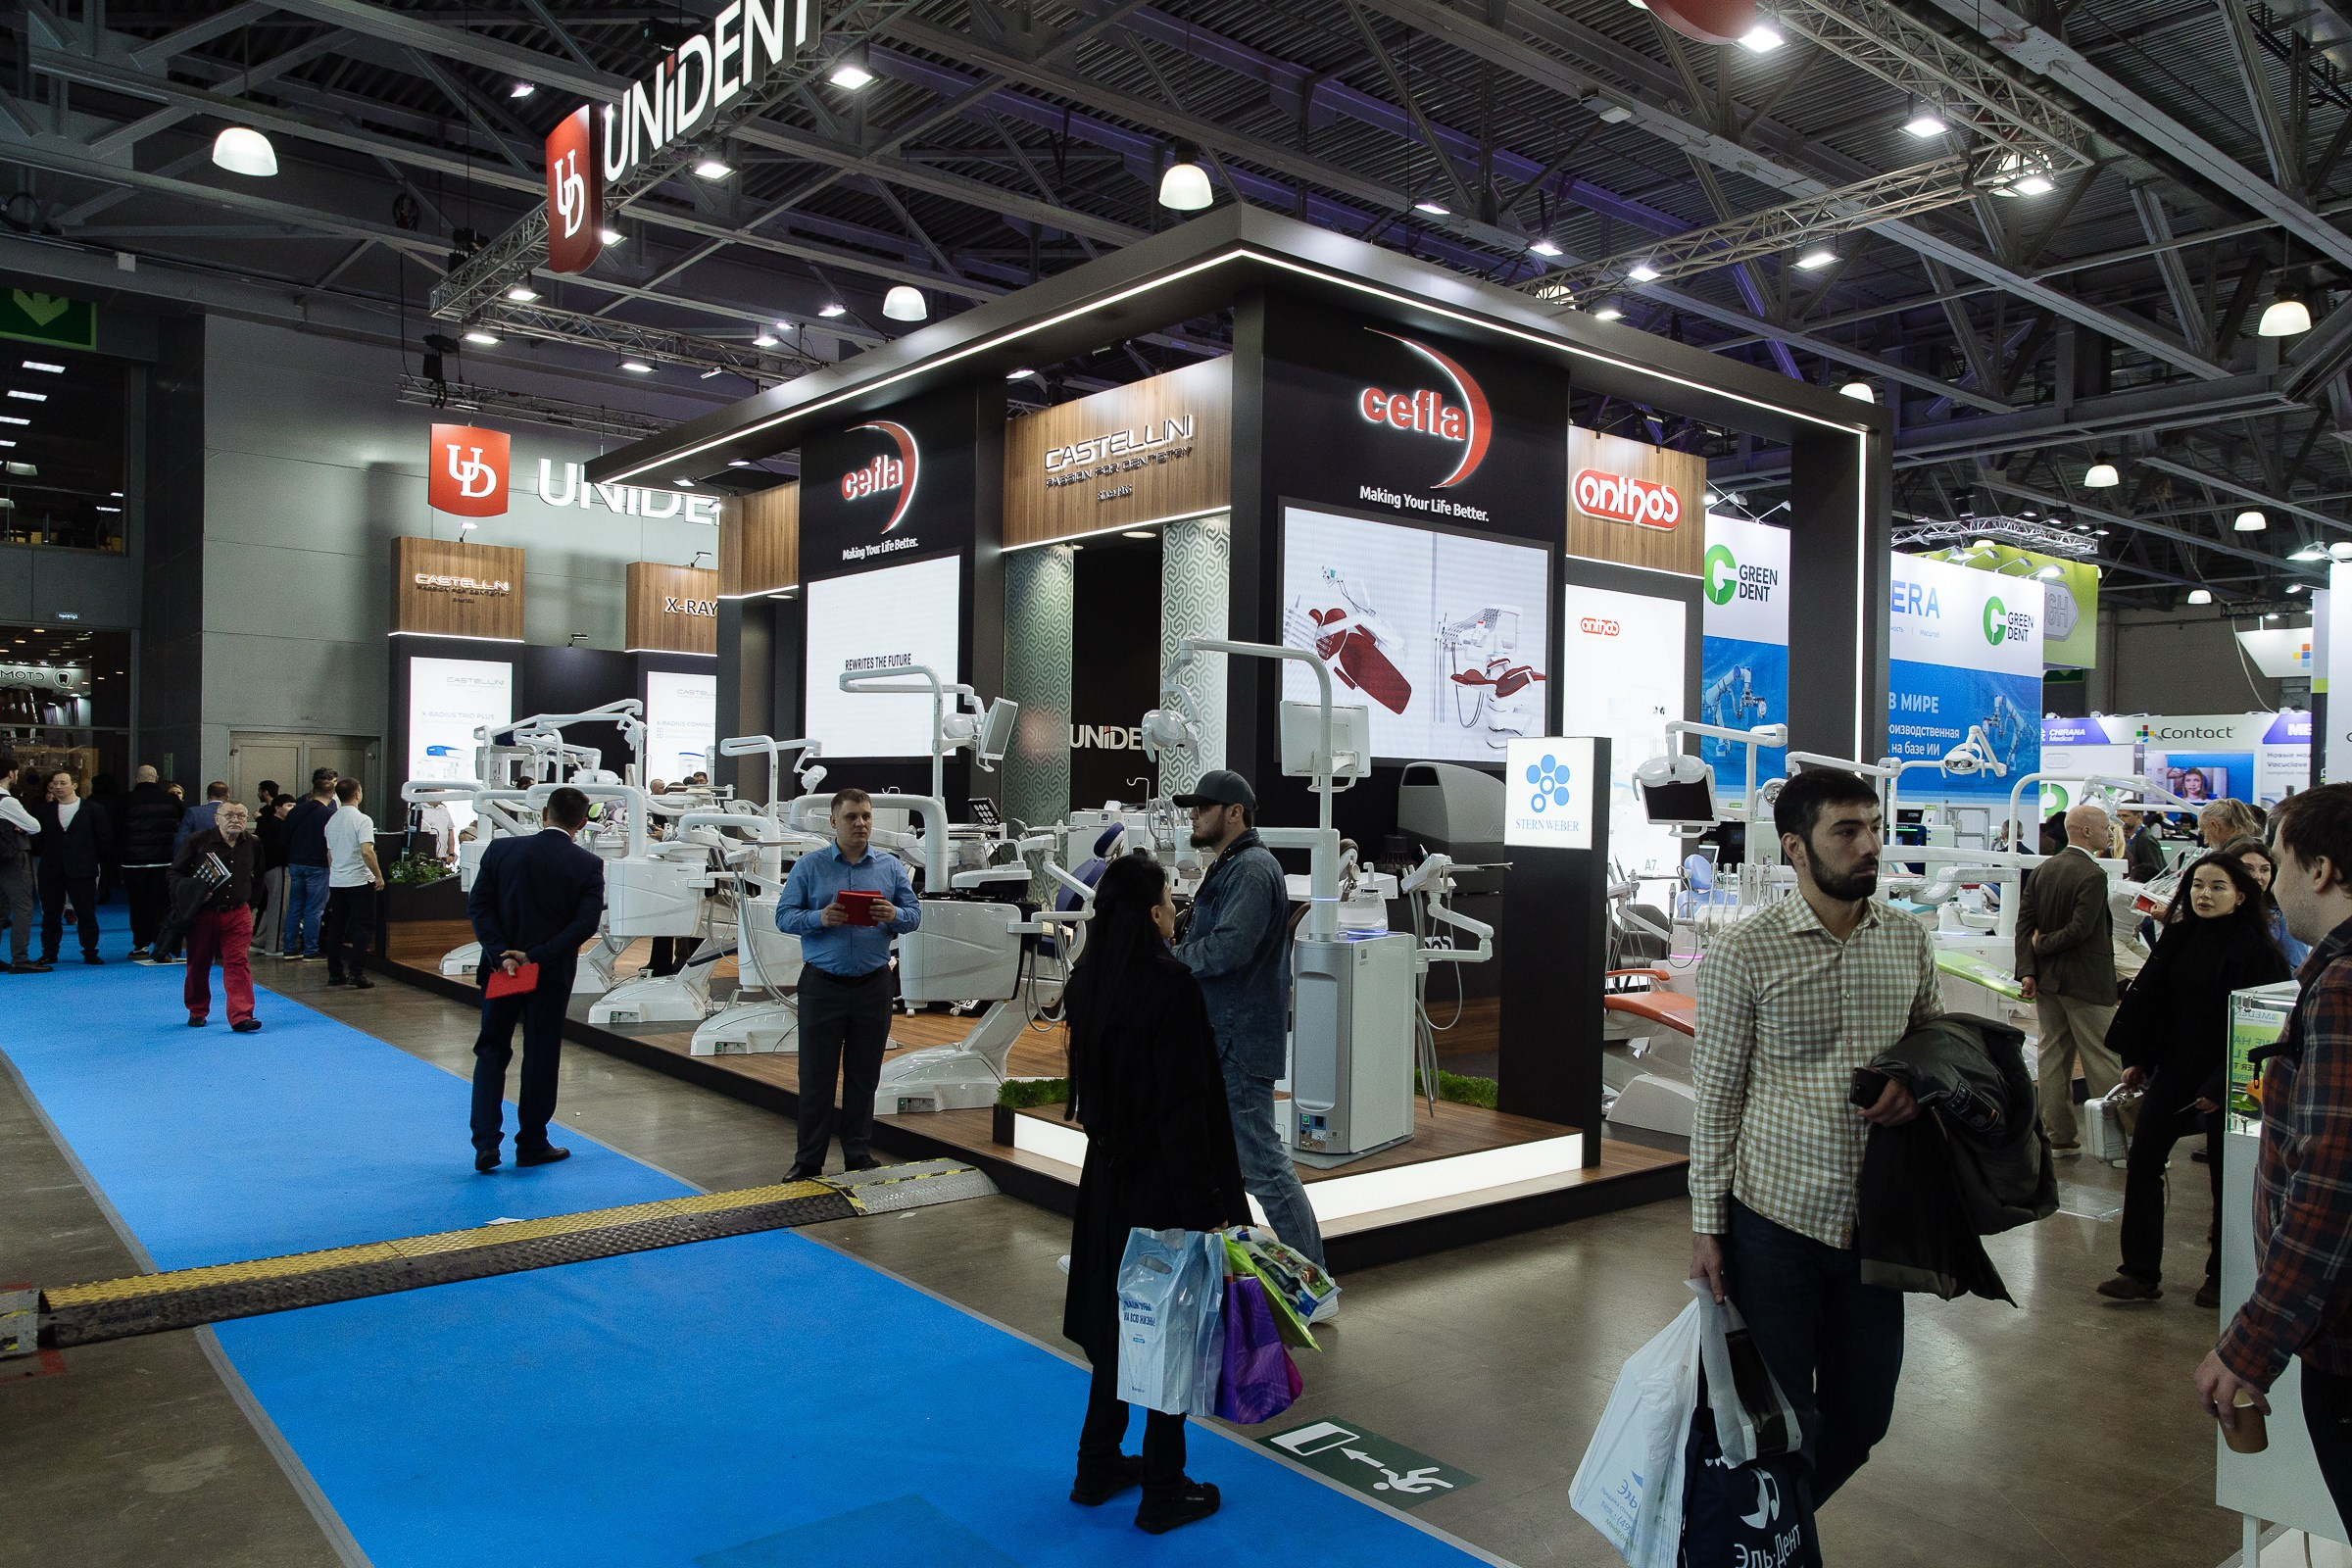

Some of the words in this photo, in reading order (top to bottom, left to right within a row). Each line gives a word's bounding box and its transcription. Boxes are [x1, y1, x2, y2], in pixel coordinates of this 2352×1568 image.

[1360, 388, 1466, 440] cefla
[1045, 415, 1193, 472] CASTELLINI
[842, 455, 903, 500] cefla
[1046, 469, 1092, 489] PASSION
[1095, 464, 1119, 478] FOR
[1122, 446, 1192, 471] DENTISTRY
[1360, 485, 1401, 509] Making
[1403, 493, 1430, 510] Your
[1431, 499, 1451, 515] Life
[1453, 503, 1490, 522] Better.
[1579, 475, 1679, 524] anthos
[843, 547, 865, 561] Making
[865, 544, 881, 556] Your
[881, 539, 895, 553] Life
[895, 537, 918, 550] Better.
[416, 573, 510, 591] CASTELLINI
[1739, 564, 1778, 586] GREEN
[1739, 582, 1770, 602] DENT
[1890, 579, 1940, 619] ERA
[665, 597, 717, 616] X-RAY
[2008, 612, 2034, 628] GREEN
[2008, 626, 2029, 642] DENT
[845, 658, 874, 671] REWRITES
[875, 656, 887, 668] THE
[888, 653, 911, 667] FUTURE
[1901, 693, 1938, 713] МИРЕ
[2161, 726, 2234, 739] Contact
[1891, 743, 1902, 754] на
[1904, 741, 1925, 756] базе
[1926, 743, 1940, 757] ИИ
[1515, 818, 1544, 830] STERN
[1544, 819, 1579, 832] WEBER
